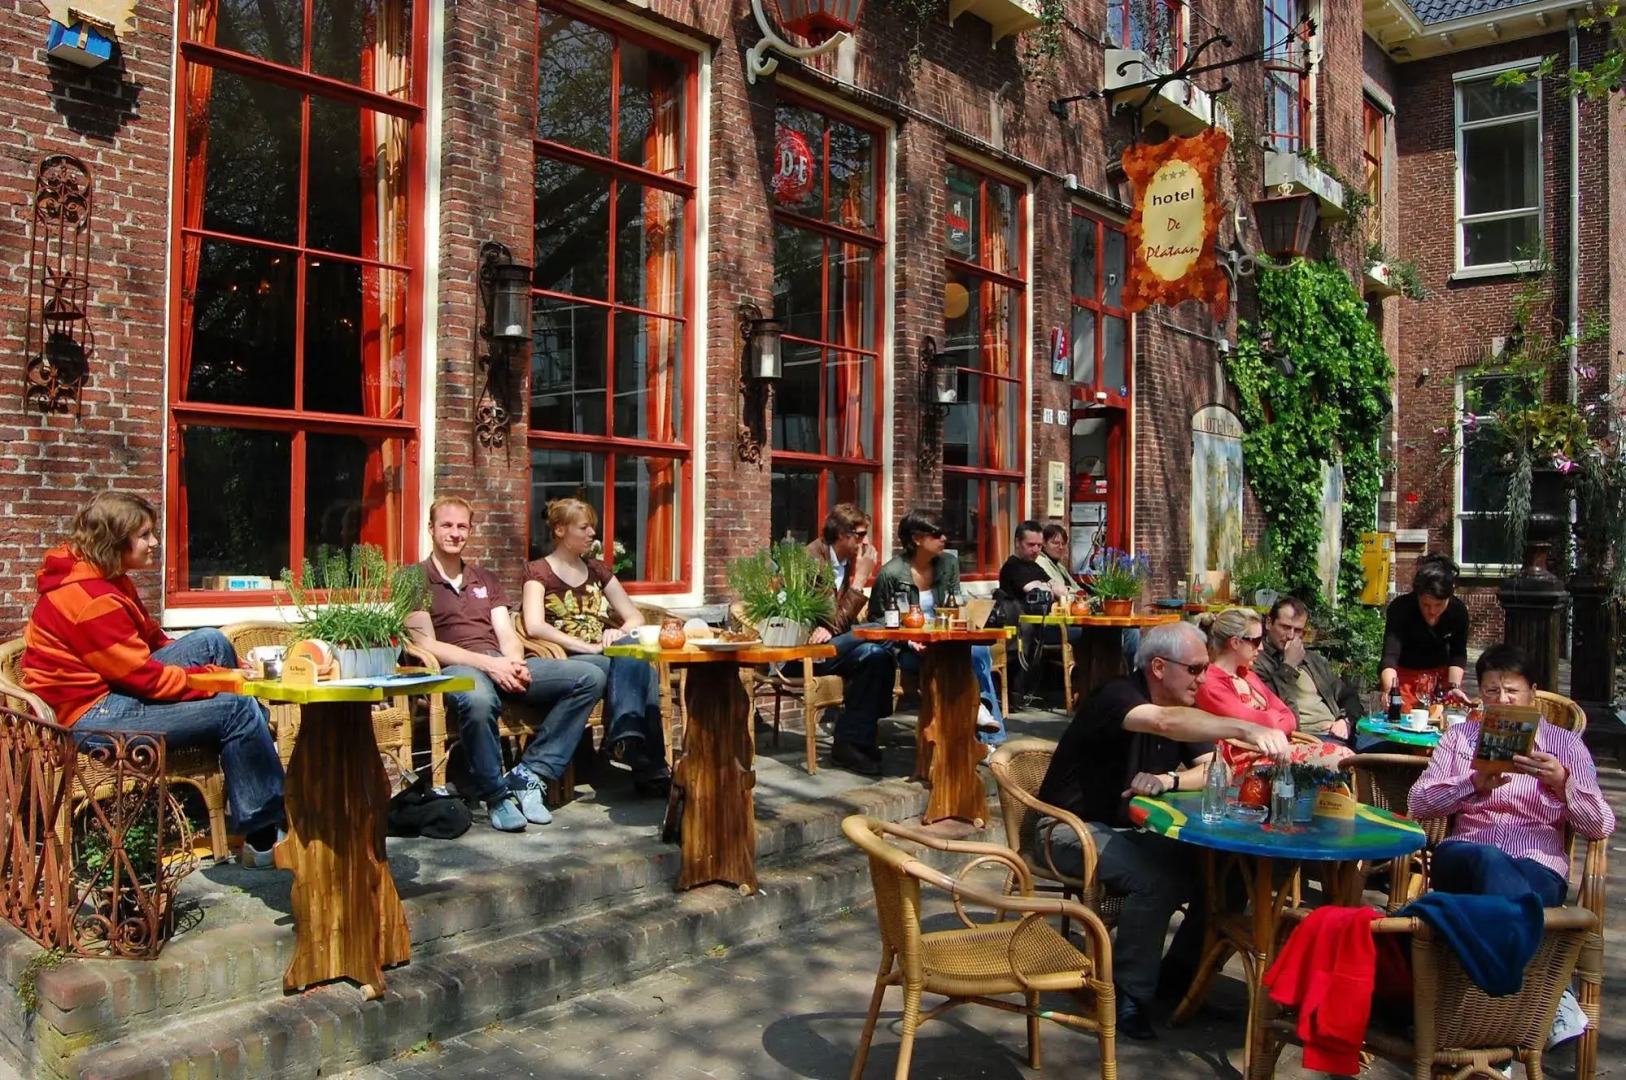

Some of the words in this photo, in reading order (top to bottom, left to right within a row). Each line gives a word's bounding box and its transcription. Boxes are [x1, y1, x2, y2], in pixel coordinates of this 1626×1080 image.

[1152, 188, 1195, 206] hotel
[1167, 218, 1181, 232] De
[1146, 245, 1199, 261] Plataan
